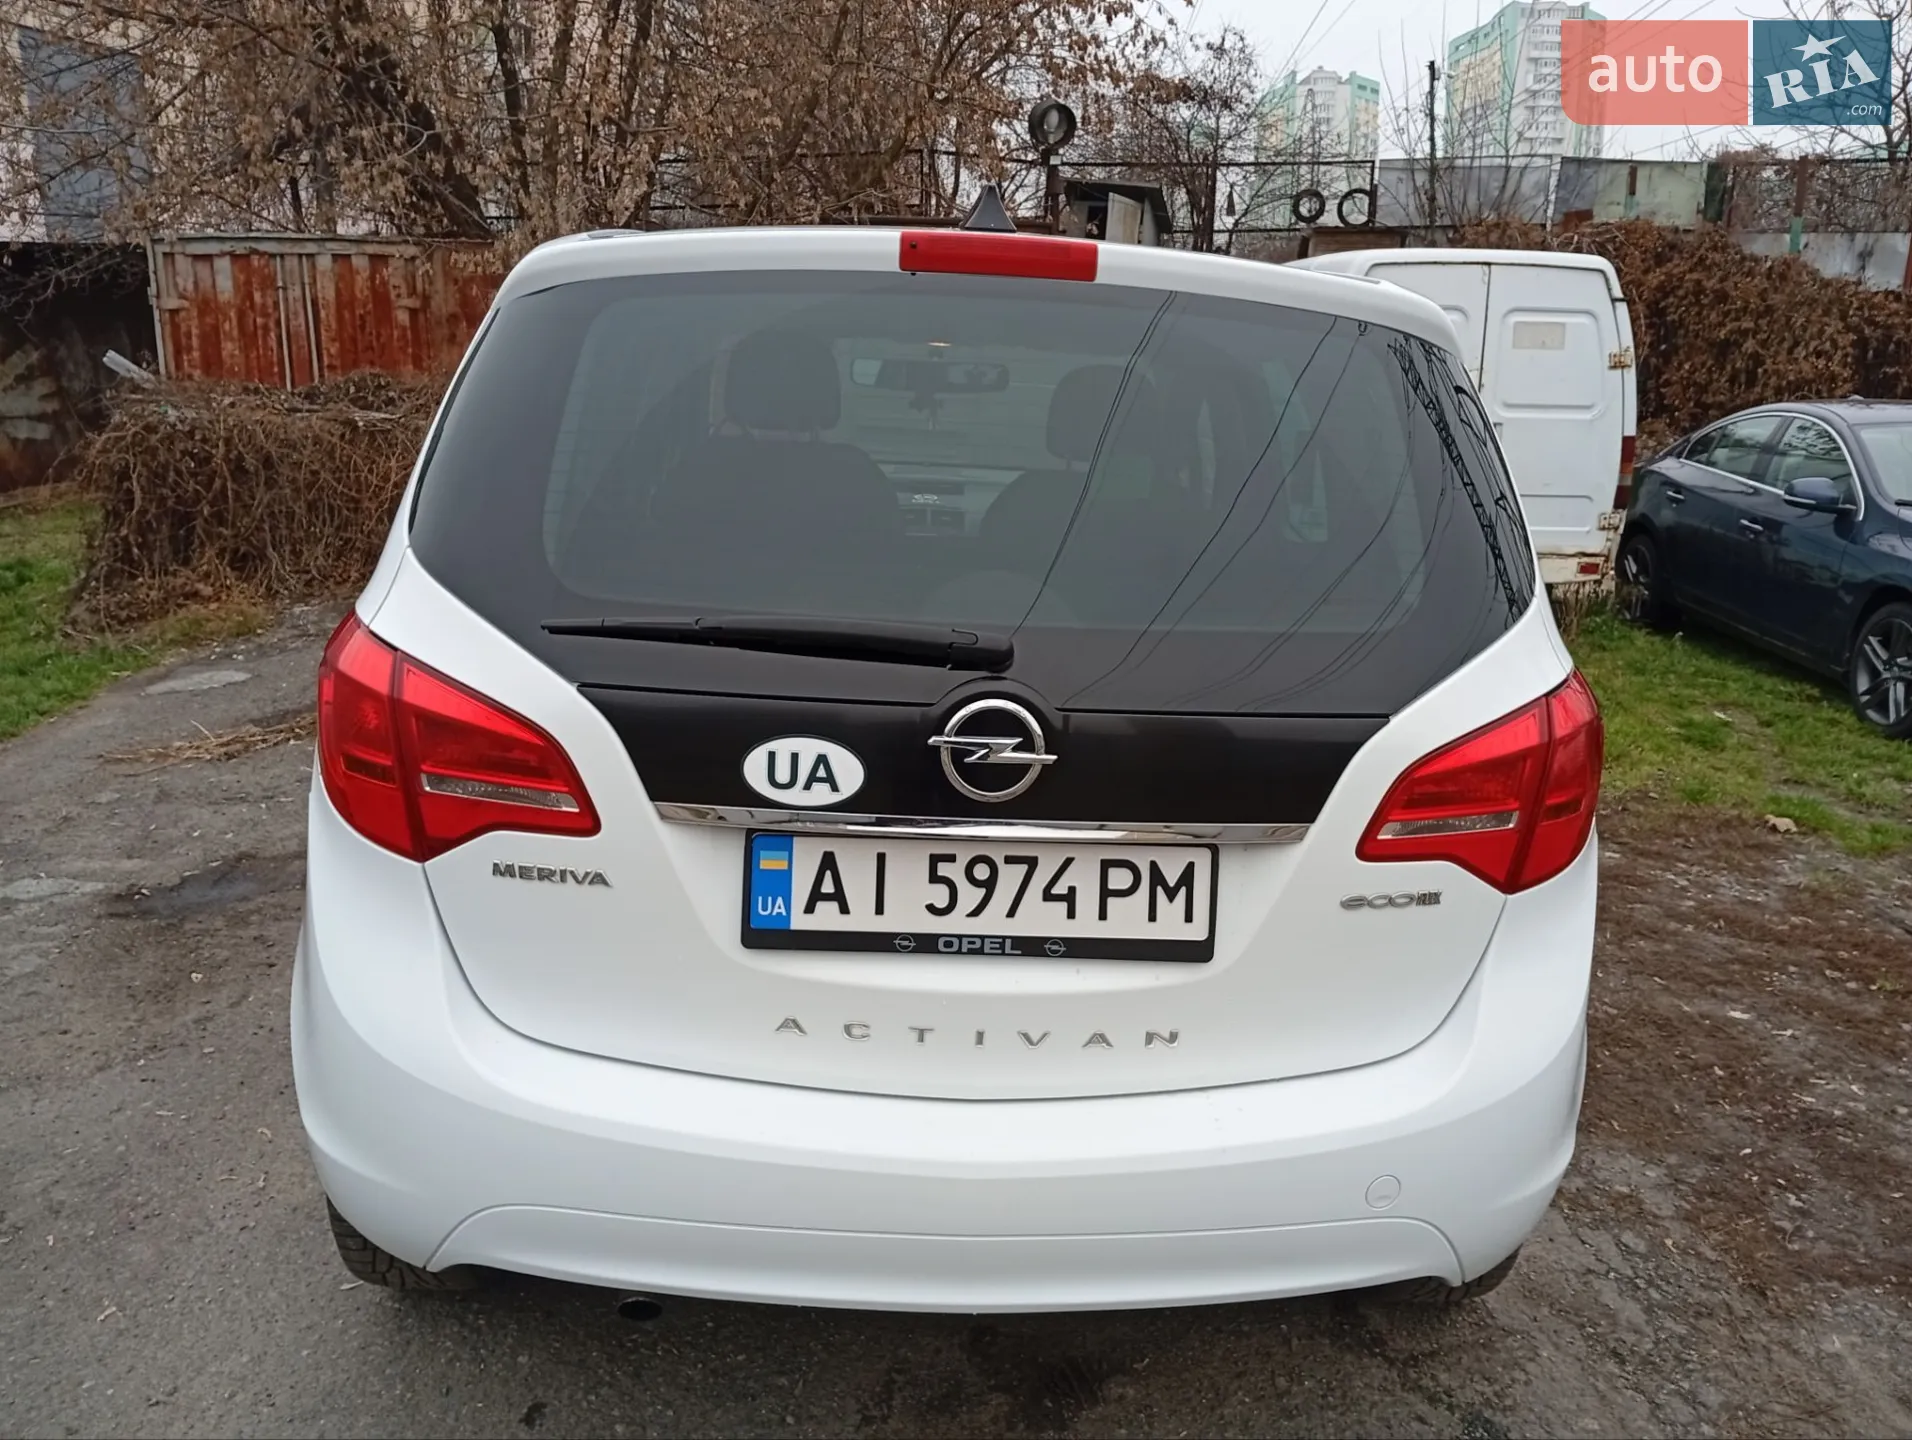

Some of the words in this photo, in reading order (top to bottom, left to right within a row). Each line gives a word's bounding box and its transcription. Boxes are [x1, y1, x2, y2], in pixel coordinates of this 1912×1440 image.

[766, 750, 841, 793] UA
[492, 860, 613, 887] MERIVA
[757, 895, 786, 916] UA
[937, 935, 1021, 955] OPEL
[774, 1015, 1181, 1049] ACTIVAN
